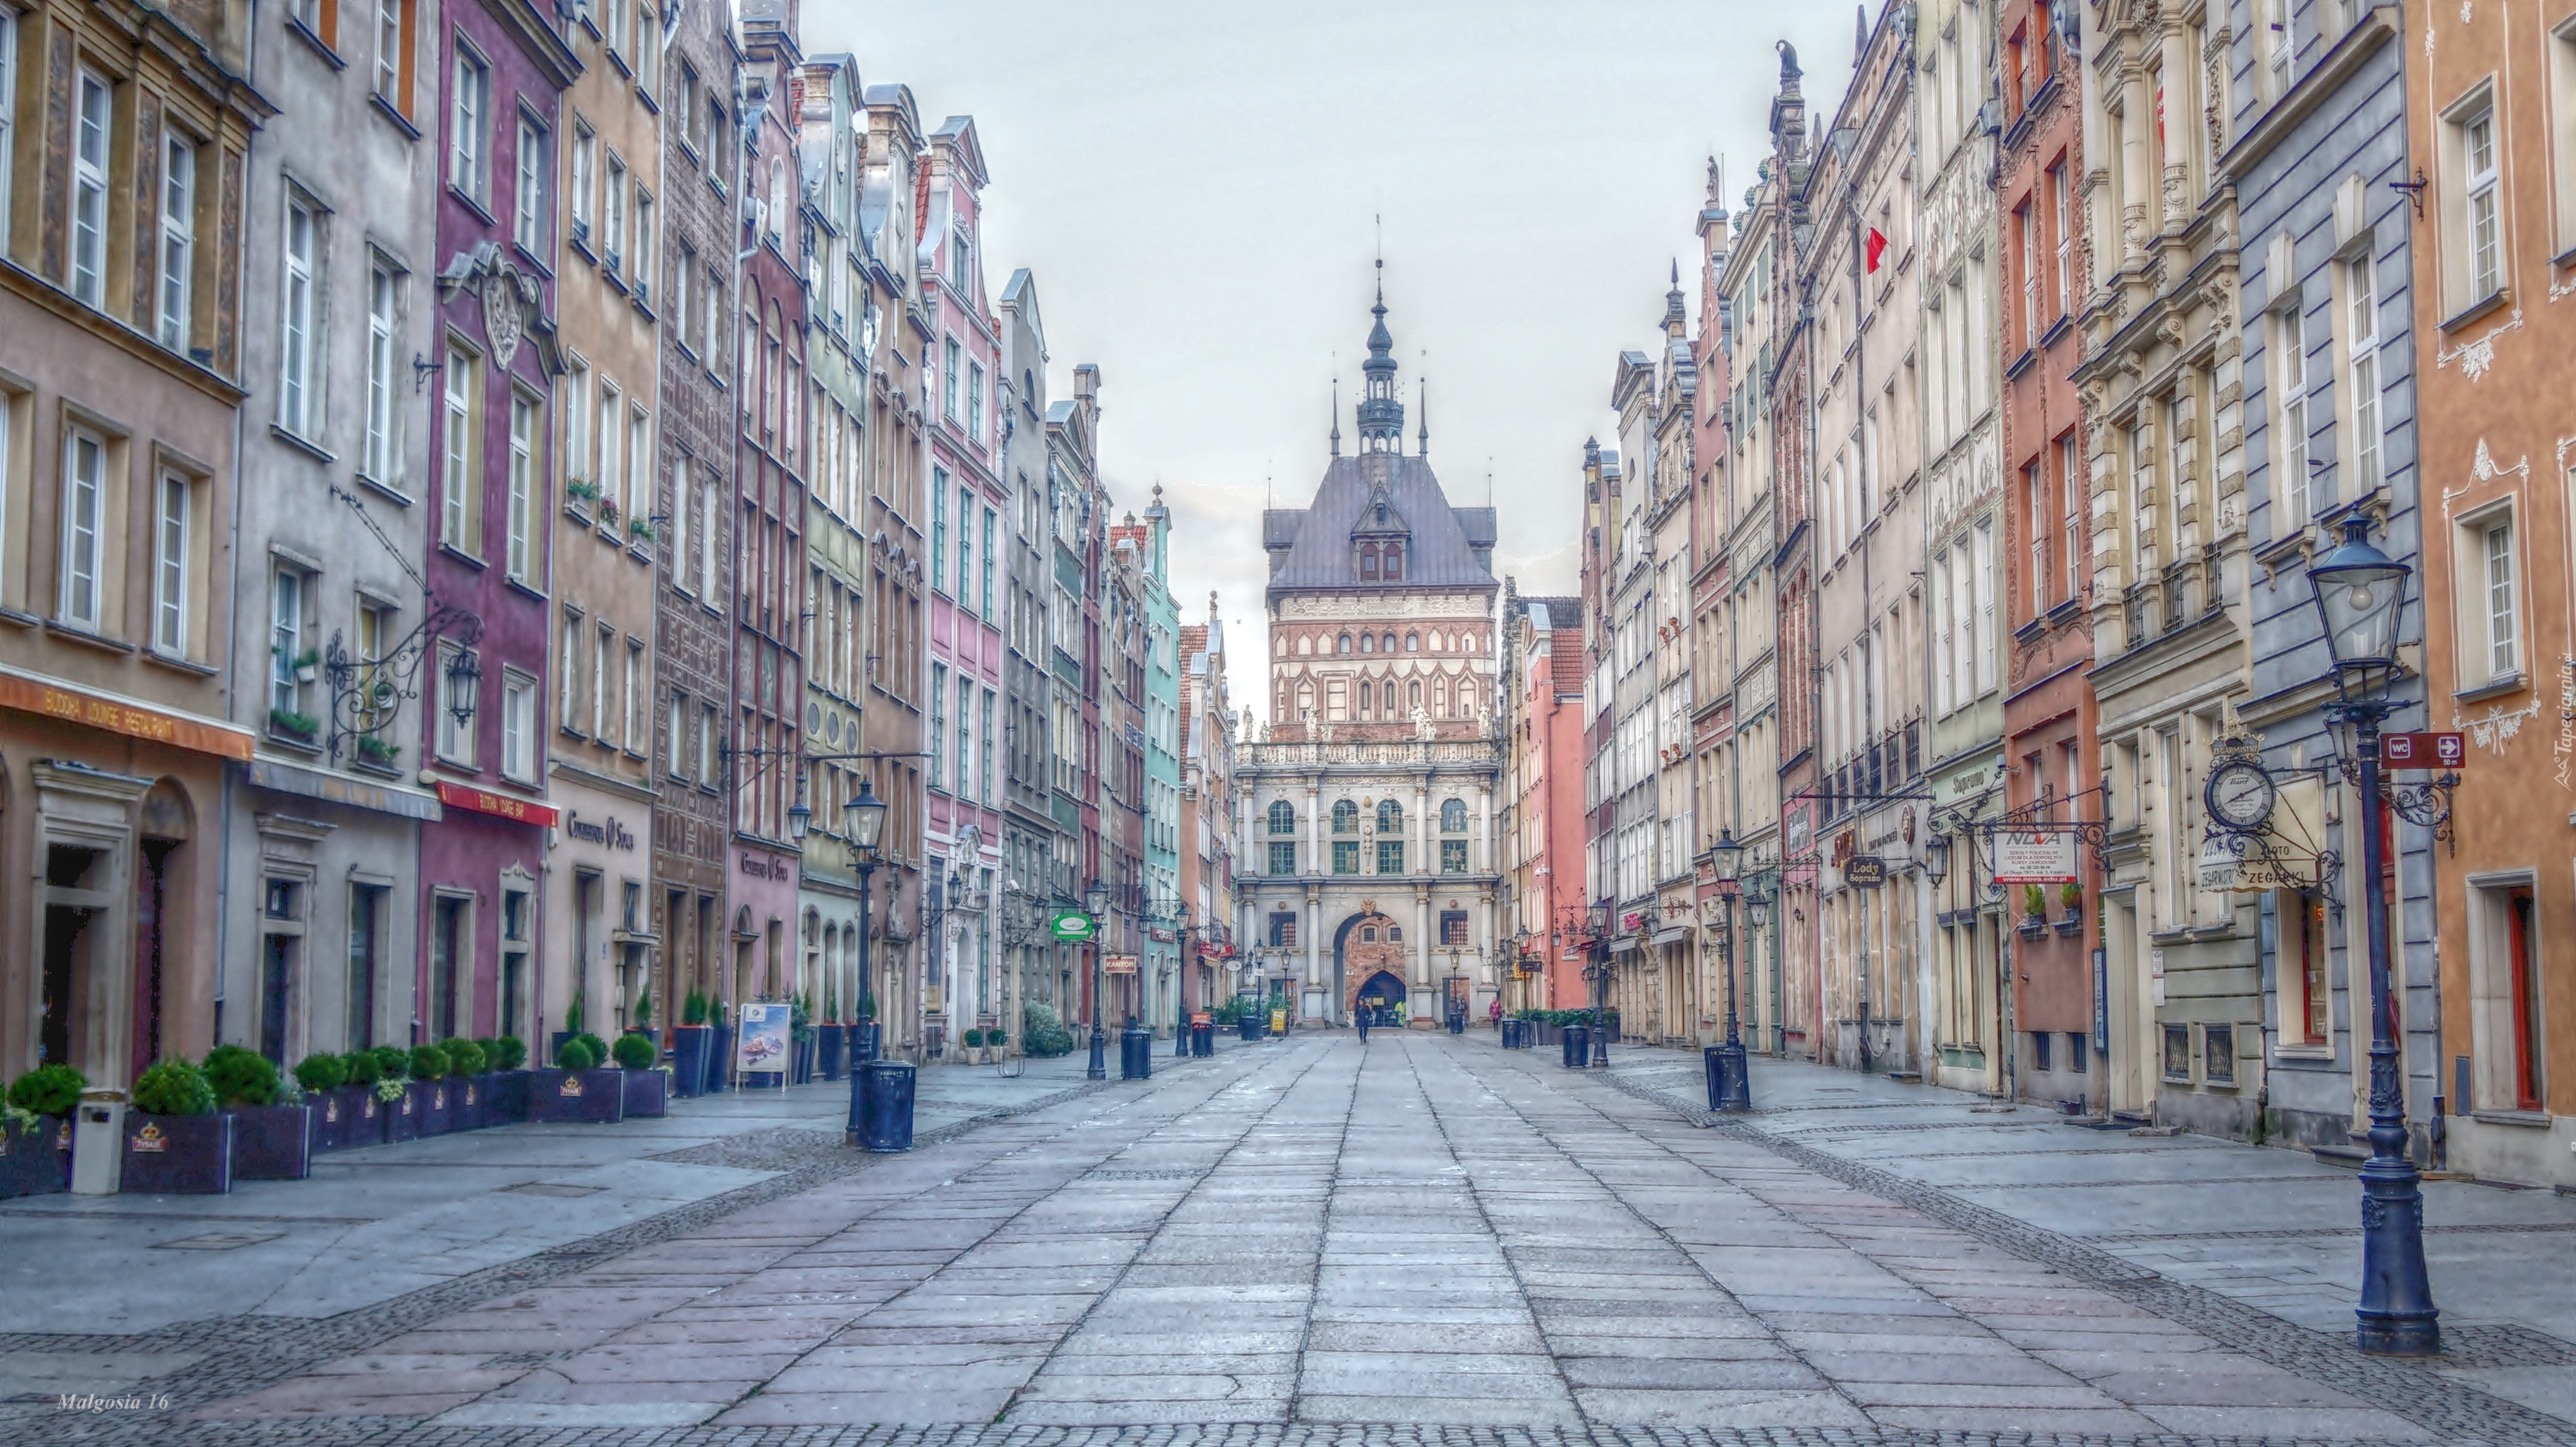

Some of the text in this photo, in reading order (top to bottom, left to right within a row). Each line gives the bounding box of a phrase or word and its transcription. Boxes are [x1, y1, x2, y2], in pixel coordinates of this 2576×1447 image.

[46, 688, 173, 739] BUDDHA LOUNGE RESTAURANT
[2213, 745, 2258, 755] ZEGARMISTRZ
[2392, 744, 2408, 753] WC
[2228, 776, 2250, 785] Tissot
[2006, 832, 2061, 845] NOVA
[1852, 861, 1880, 875] Lody
[1849, 873, 1881, 884] Soprano
[2202, 867, 2235, 888] ZEGARMISTRZ
